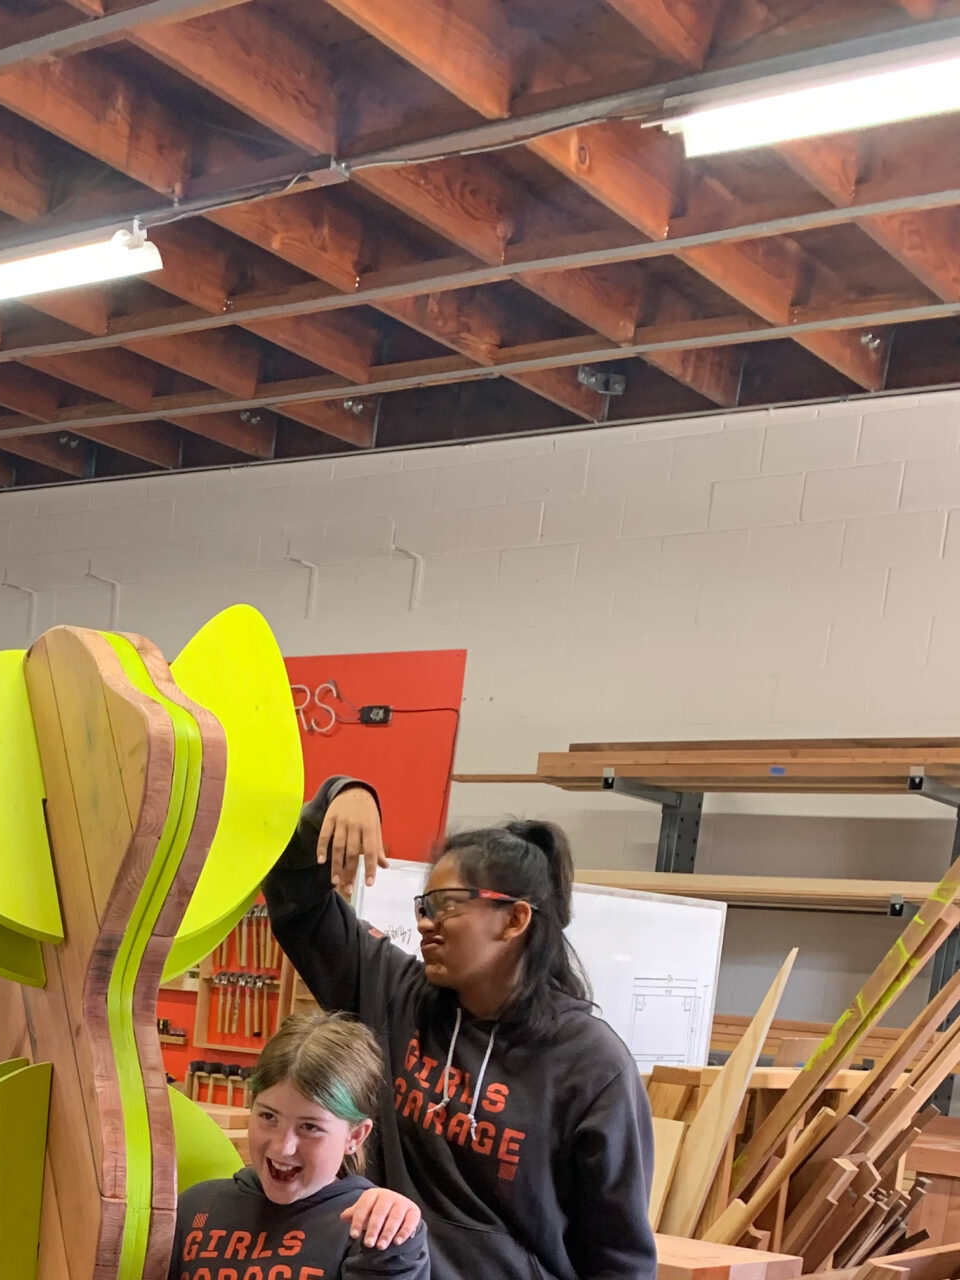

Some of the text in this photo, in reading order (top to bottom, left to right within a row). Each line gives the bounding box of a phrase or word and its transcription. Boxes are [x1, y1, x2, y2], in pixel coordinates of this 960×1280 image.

[404, 1038, 509, 1113] GIRLS
[394, 1076, 526, 1164] GARAGE
[183, 1229, 306, 1262] GIRLS
